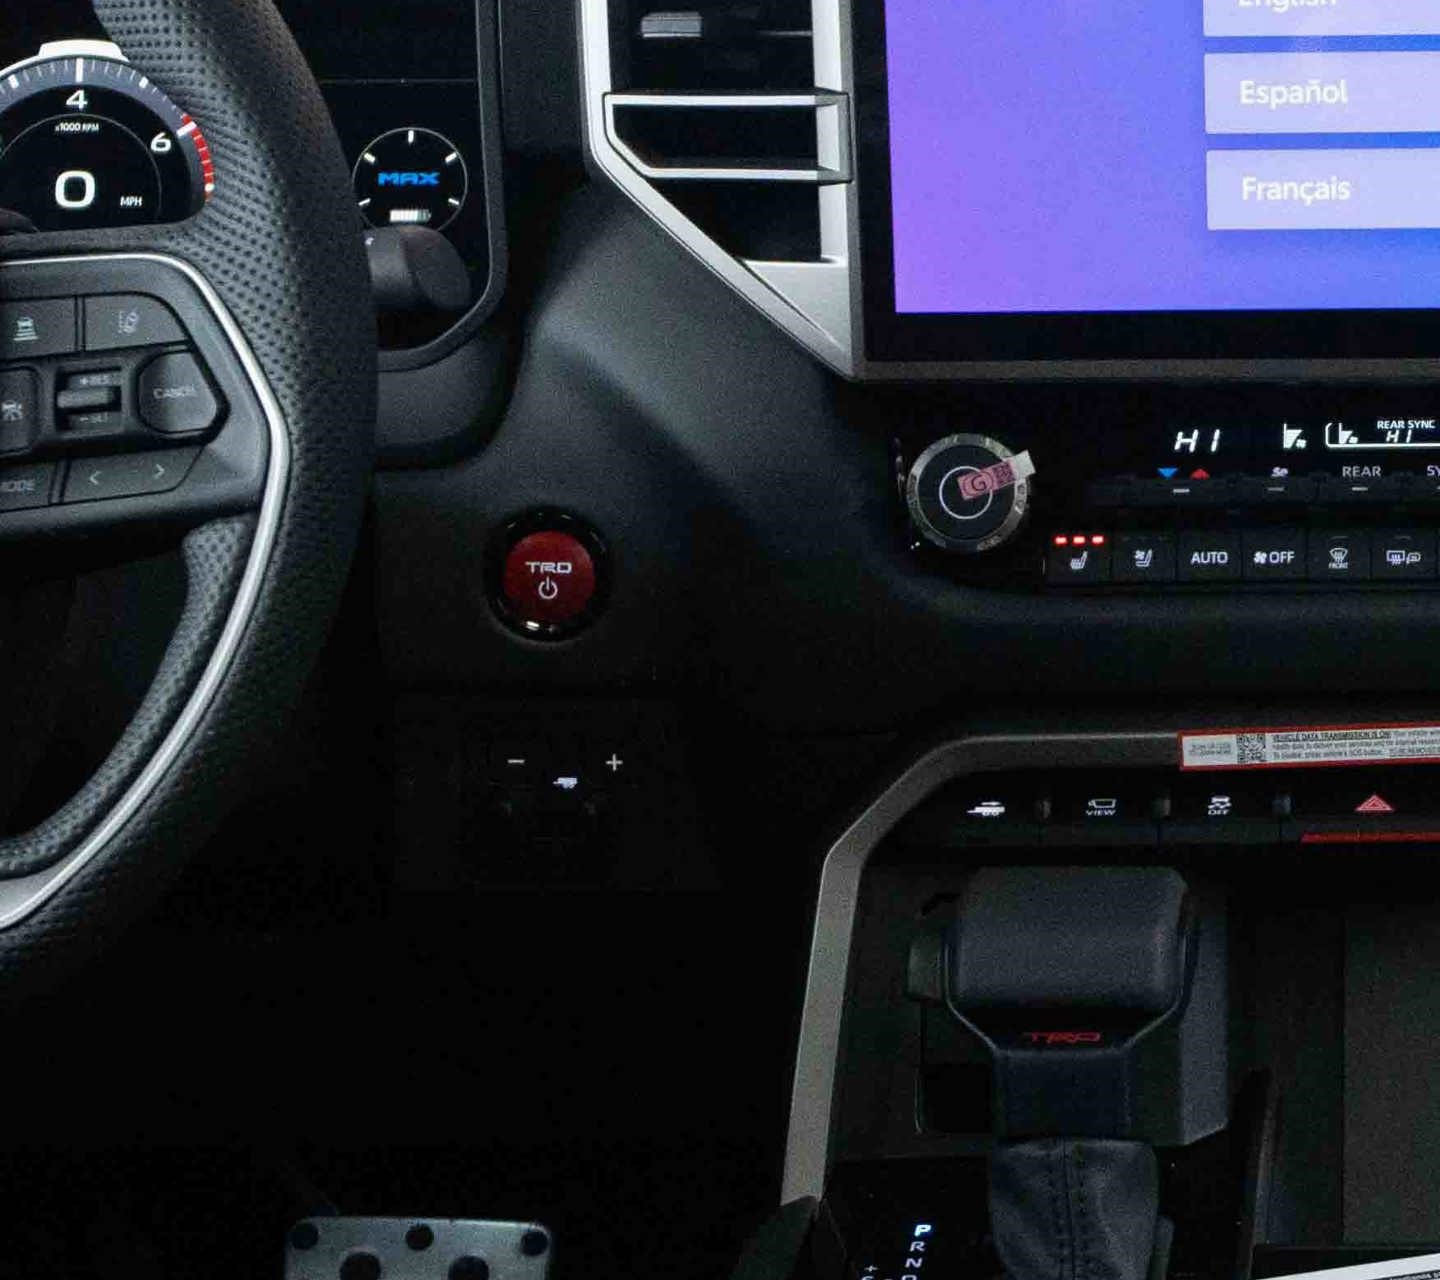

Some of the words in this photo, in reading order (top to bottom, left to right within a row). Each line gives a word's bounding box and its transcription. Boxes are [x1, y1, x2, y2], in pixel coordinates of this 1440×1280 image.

[66, 89, 88, 109] 4
[1239, 80, 1348, 109] Español
[151, 132, 171, 152] 6
[377, 172, 440, 186] MAX
[55, 170, 95, 208] 0
[1241, 176, 1351, 205] Français
[120, 196, 142, 207] MPH
[1377, 420, 1405, 430] REAR
[1407, 420, 1436, 430] SYNC
[1342, 465, 1381, 478] REAR
[1190, 551, 1229, 564] AUTO
[1268, 551, 1295, 564] OFF
[525, 561, 573, 574] TRD
[914, 1224, 932, 1237] P
[909, 1241, 926, 1253] R
[904, 1258, 923, 1269] N
